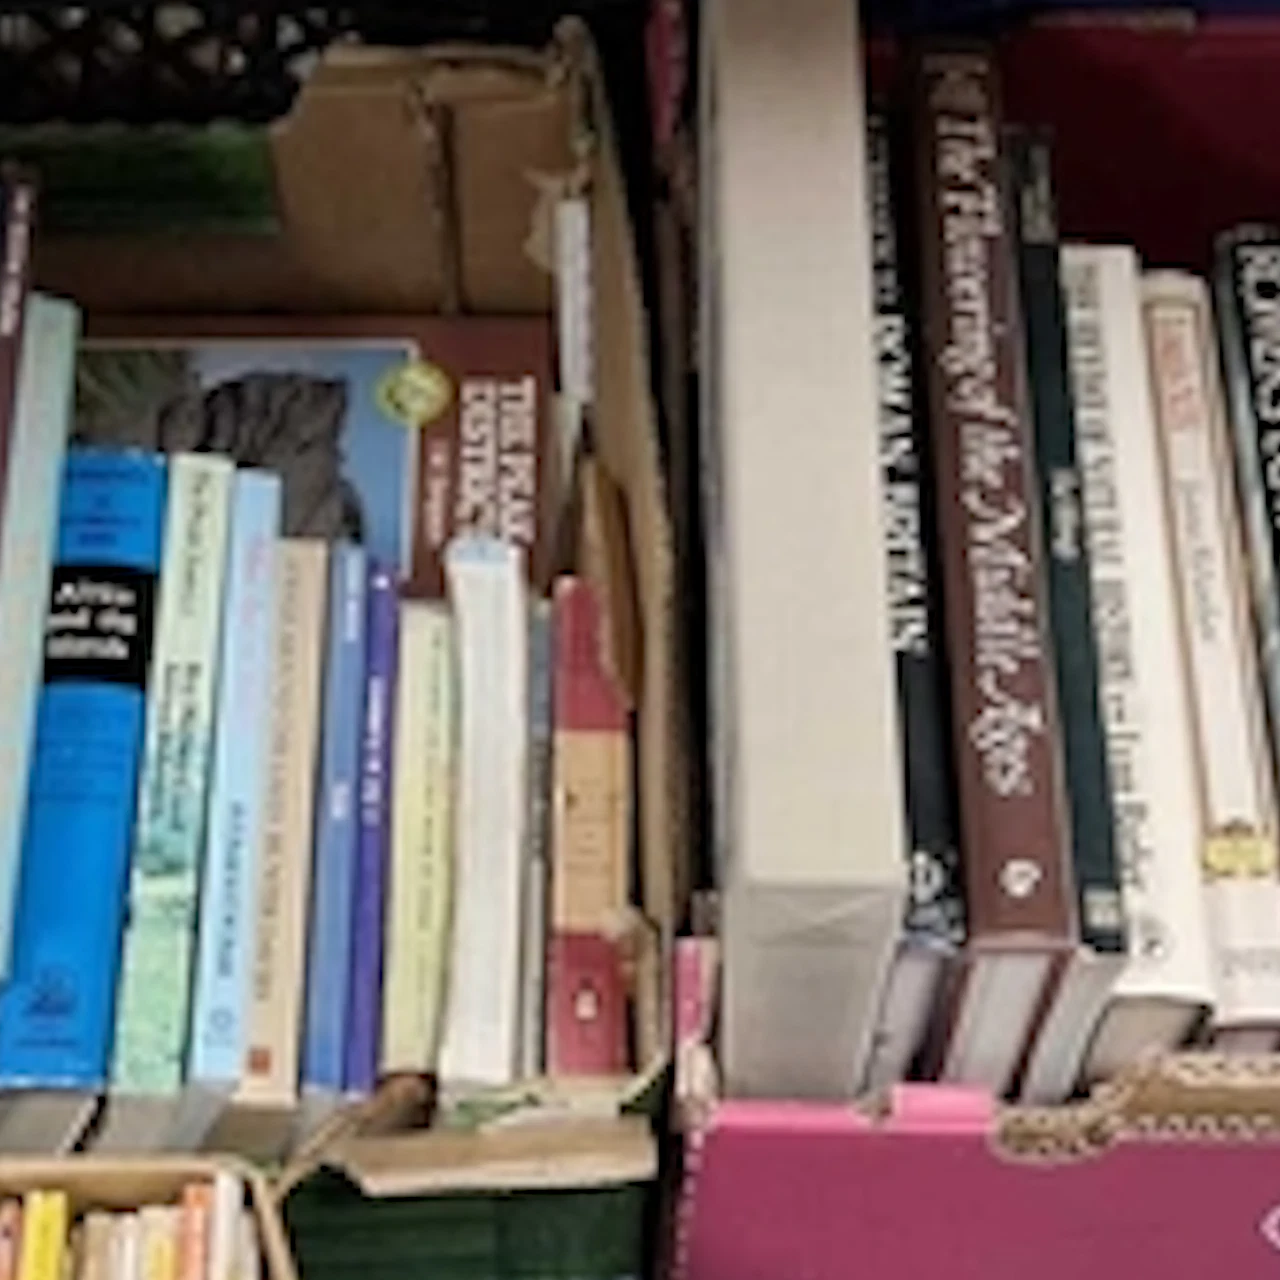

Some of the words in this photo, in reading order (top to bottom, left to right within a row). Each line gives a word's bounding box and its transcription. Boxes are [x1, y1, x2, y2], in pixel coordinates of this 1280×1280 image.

[936, 109, 997, 186] The
[928, 184, 1013, 383] Flowering
[498, 375, 535, 448] THE
[869, 311, 918, 469] ROMAN
[952, 378, 1019, 429] of
[498, 453, 535, 545] PEAK
[961, 424, 1019, 481] the
[880, 477, 931, 655] BRITAIN
[960, 483, 1036, 675] Middle
[964, 668, 1049, 798] Ages
